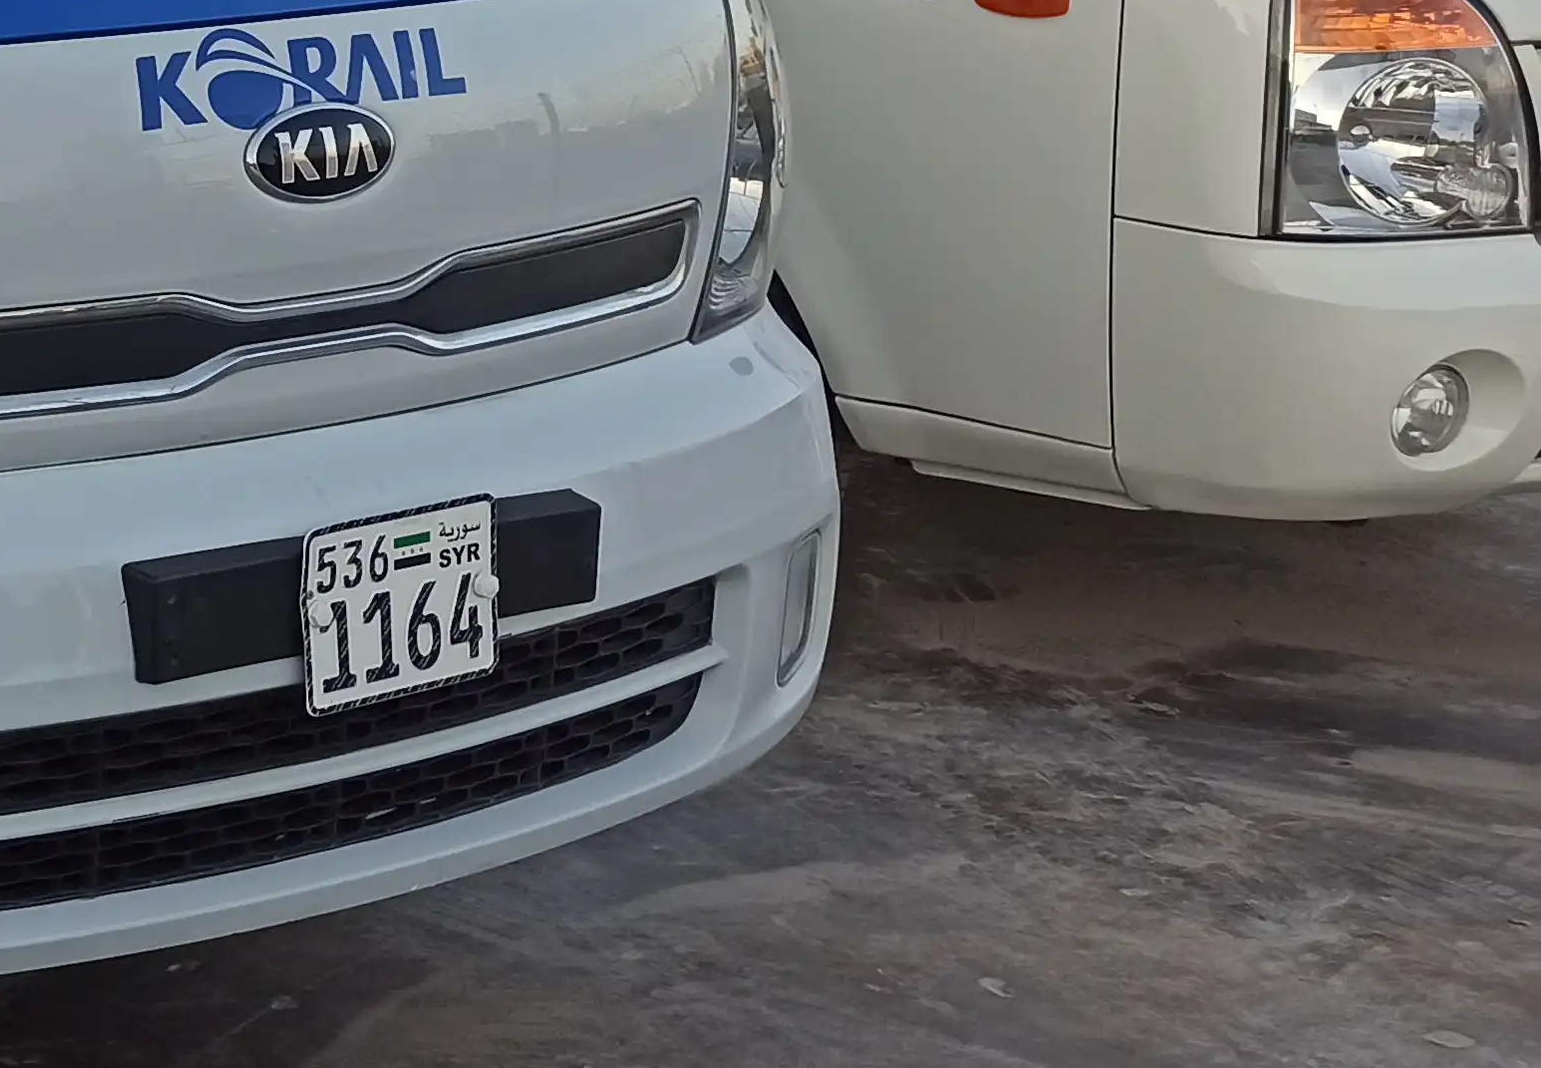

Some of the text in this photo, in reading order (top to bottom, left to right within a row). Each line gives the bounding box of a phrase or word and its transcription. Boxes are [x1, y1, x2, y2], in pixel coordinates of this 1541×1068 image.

[135, 27, 467, 131] KORAIL
[276, 122, 379, 184] KIA
[438, 522, 481, 539] سورية
[438, 542, 481, 568] SYR
[316, 534, 389, 594] 536
[319, 572, 484, 694] 1164
